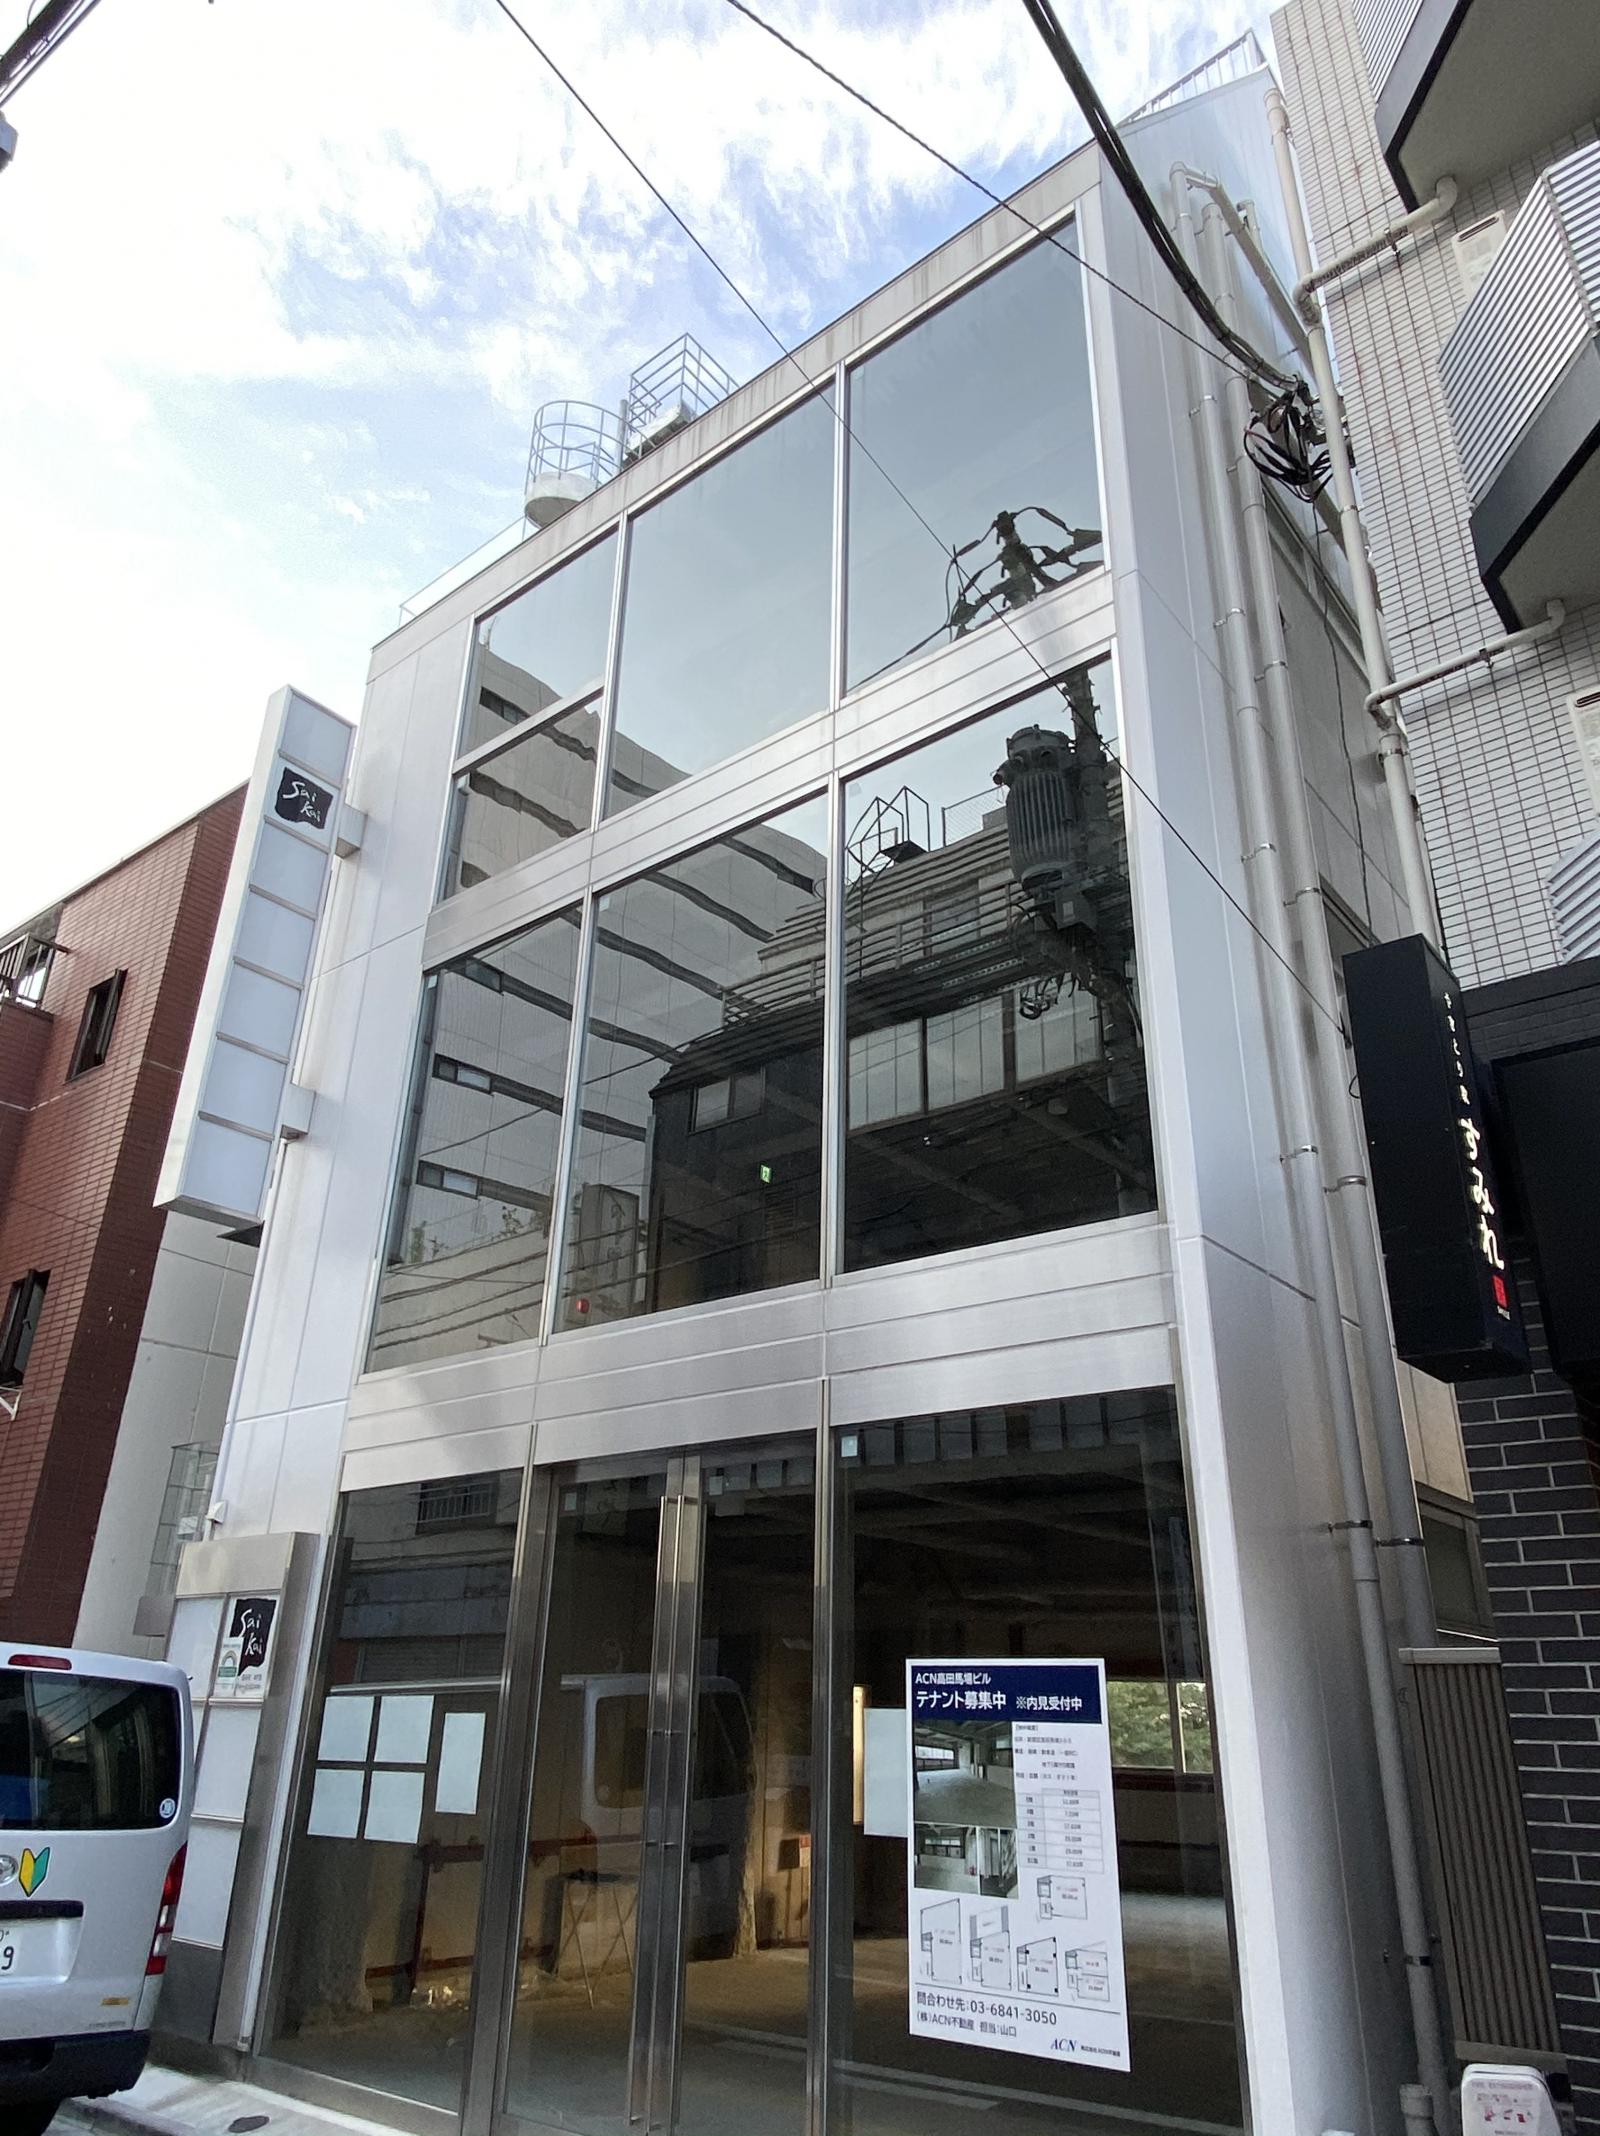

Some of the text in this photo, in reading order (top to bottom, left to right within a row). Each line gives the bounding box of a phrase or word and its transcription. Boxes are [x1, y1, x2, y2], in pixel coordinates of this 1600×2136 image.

[282, 781, 316, 802] Sai
[239, 1608, 262, 1637] Sai
[915, 1672, 992, 1686] ACN高田馬場ビル
[916, 1690, 1007, 1710] テナント募集中
[1050, 2037, 1078, 2053] ACN
